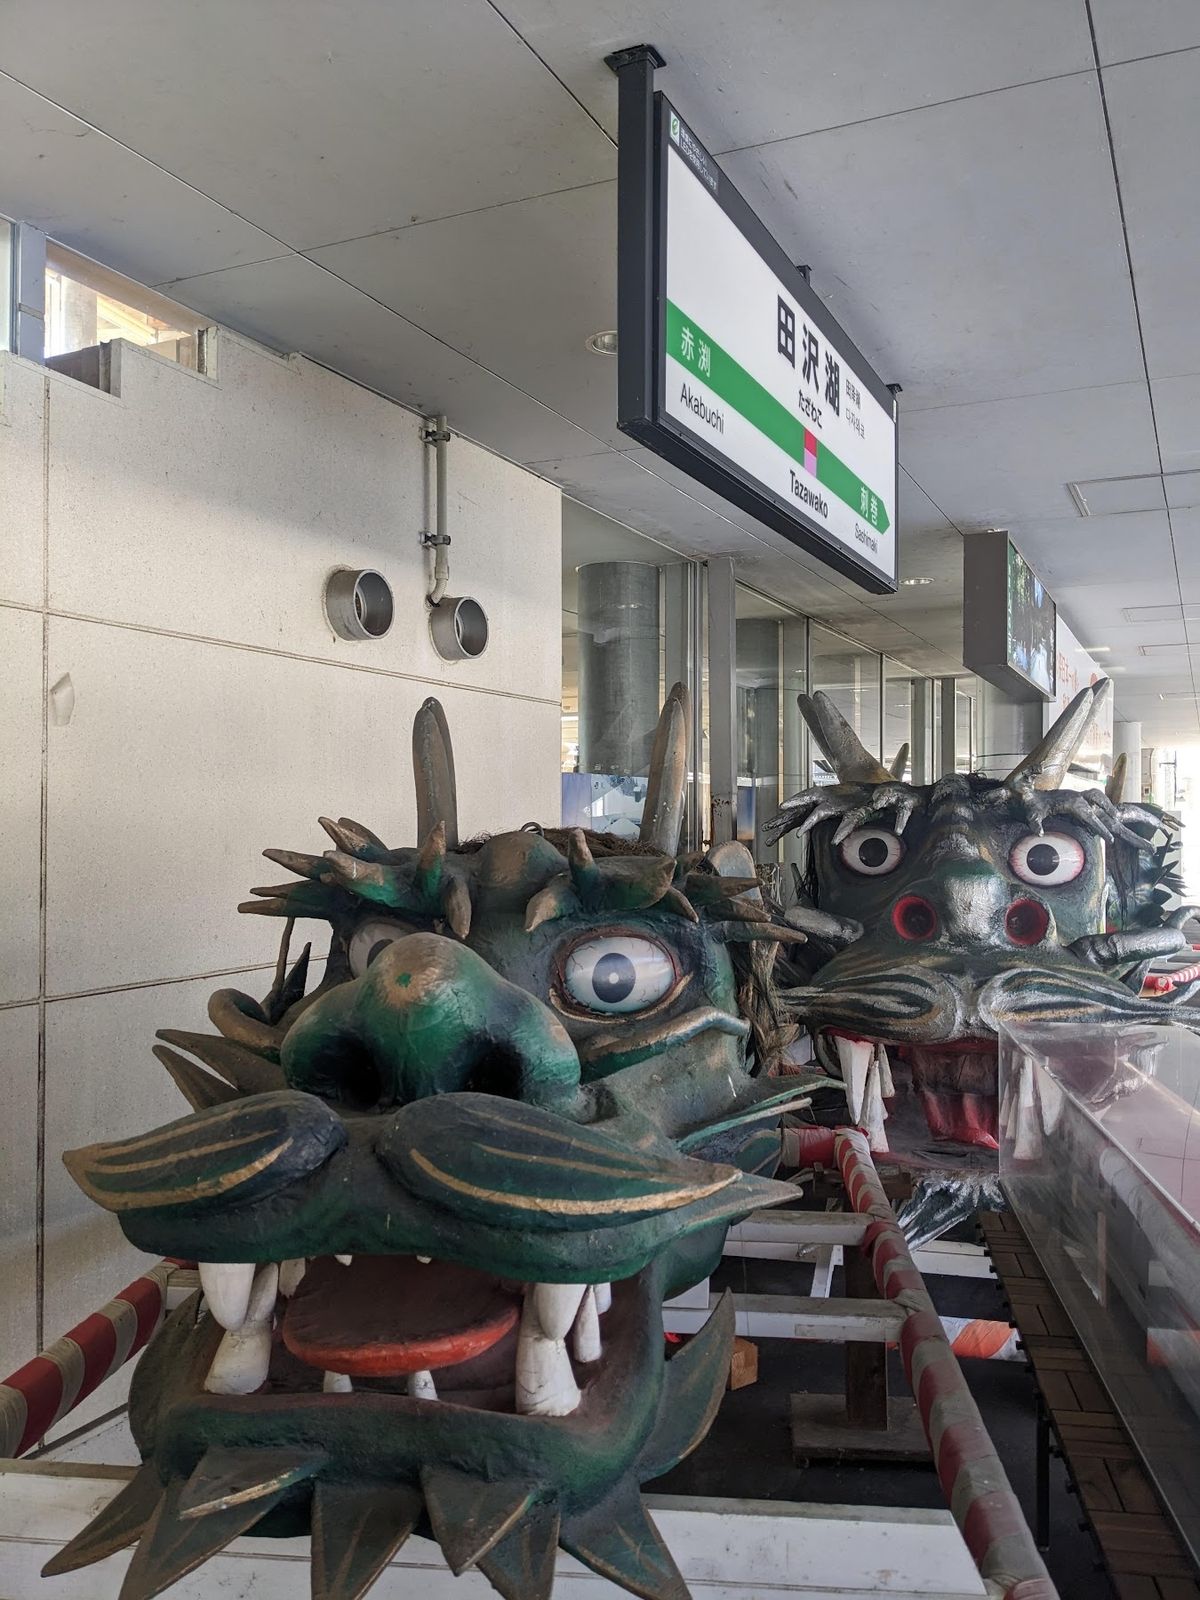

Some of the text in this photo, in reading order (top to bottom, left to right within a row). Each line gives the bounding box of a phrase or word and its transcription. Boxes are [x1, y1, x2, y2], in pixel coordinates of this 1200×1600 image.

[680, 325, 712, 378] 赤渕
[777, 294, 841, 417] 田沢湖
[680, 383, 725, 434] Akabuchi
[798, 388, 823, 430] たざわこ
[845, 408, 866, 440] 다자와코
[789, 469, 829, 519] Tazawako
[860, 486, 879, 527] 刺巻
[854, 523, 878, 554] Sashimaki
